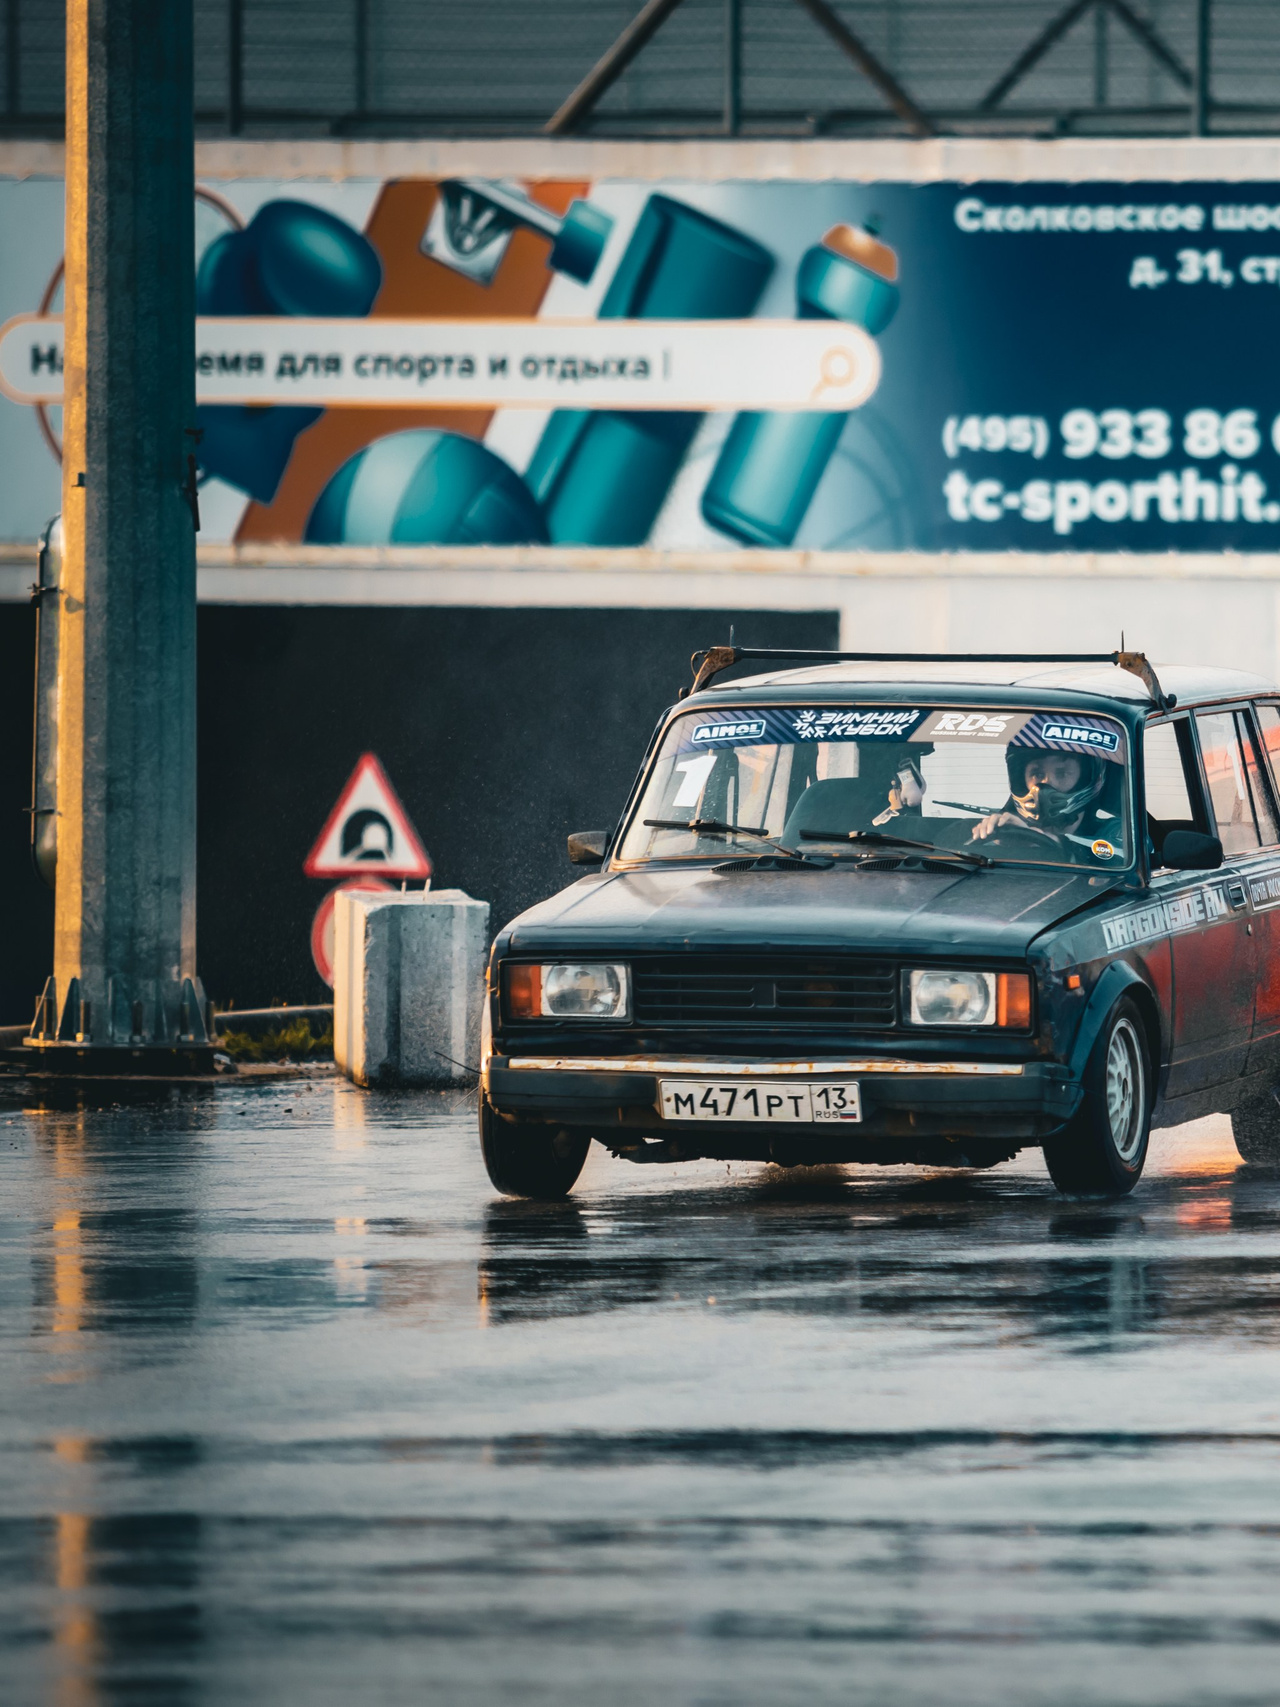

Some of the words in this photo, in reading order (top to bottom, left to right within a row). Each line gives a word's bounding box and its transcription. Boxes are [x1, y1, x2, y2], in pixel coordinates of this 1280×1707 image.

[954, 197, 1204, 232] Сколковское
[1129, 256, 1168, 288] д.
[1176, 249, 1233, 287] 31,
[196, 353, 265, 375] емя
[275, 353, 343, 381] для
[353, 353, 477, 387] спорта
[489, 355, 509, 378] и
[520, 355, 653, 384] отдыха
[942, 414, 1050, 460] (495)
[1059, 409, 1171, 460] 933
[1183, 409, 1260, 460] 86
[815, 709, 920, 724] ЗИМНИЙ
[934, 713, 1014, 733] RDS
[695, 722, 761, 740] AIMOL
[828, 723, 910, 736] КУБОК
[1045, 726, 1115, 748] AIMOL
[816, 1087, 848, 1109] 13
